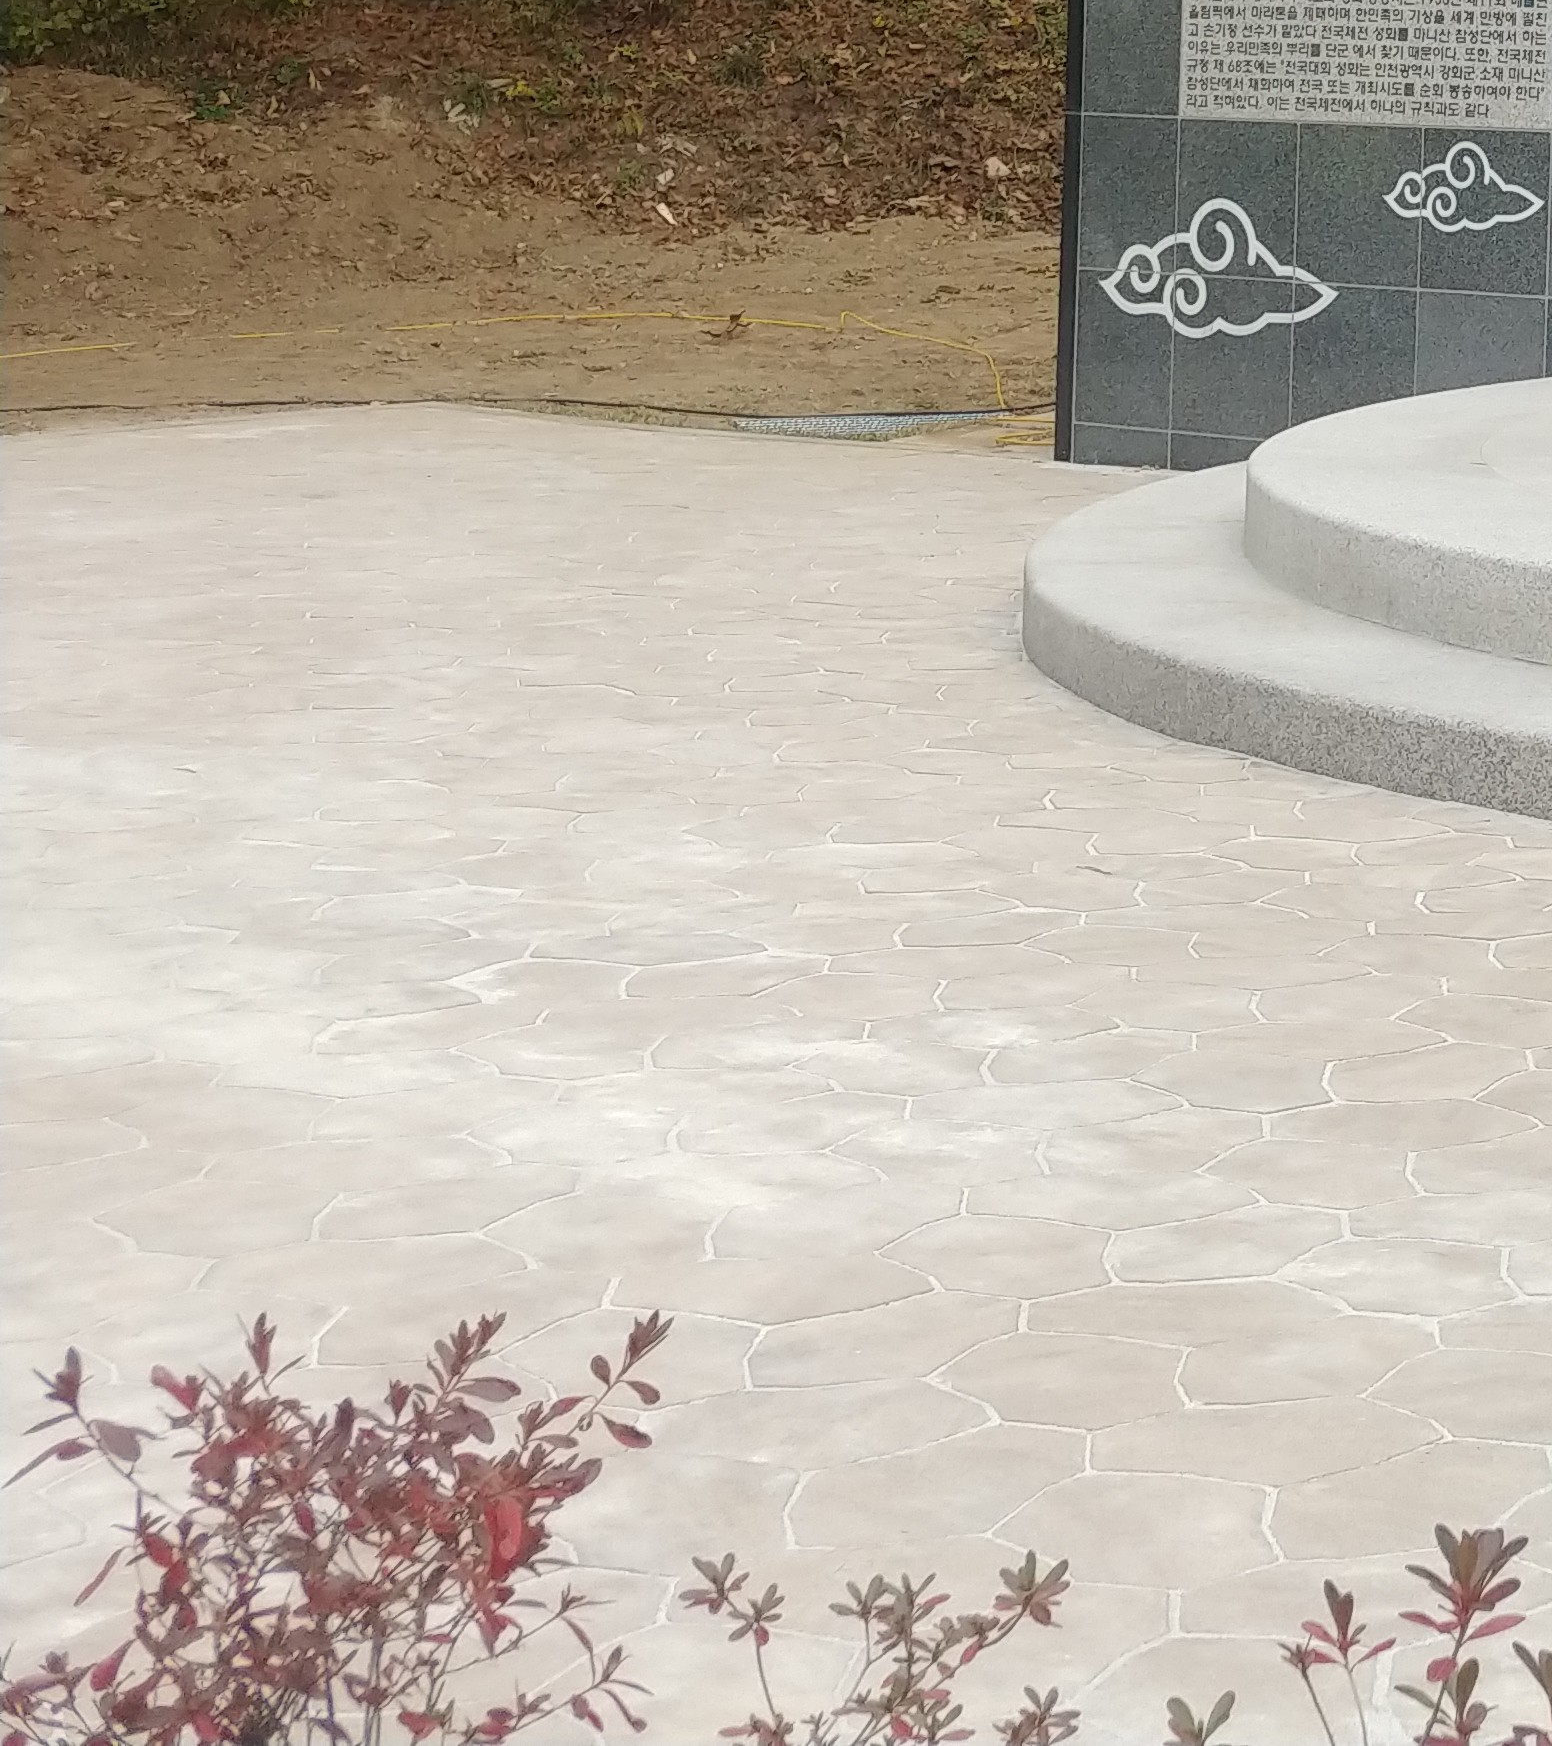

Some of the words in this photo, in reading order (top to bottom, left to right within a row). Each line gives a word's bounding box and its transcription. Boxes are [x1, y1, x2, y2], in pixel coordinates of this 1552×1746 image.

[1188, 23, 1199, 37] 고
[1203, 23, 1237, 38] 손기정
[1242, 24, 1277, 38] 선수가
[1321, 25, 1369, 40] 전국체전
[1414, 27, 1450, 43] 마니산
[1188, 41, 1220, 55] 이유는
[1497, 48, 1546, 64] 전국체전
[1375, 62, 1434, 79] 인천광역시
[1299, 79, 1323, 93] 전국
[1326, 79, 1350, 94] 또는
[1186, 94, 1208, 108] 라고
[1267, 96, 1290, 111] 이는
